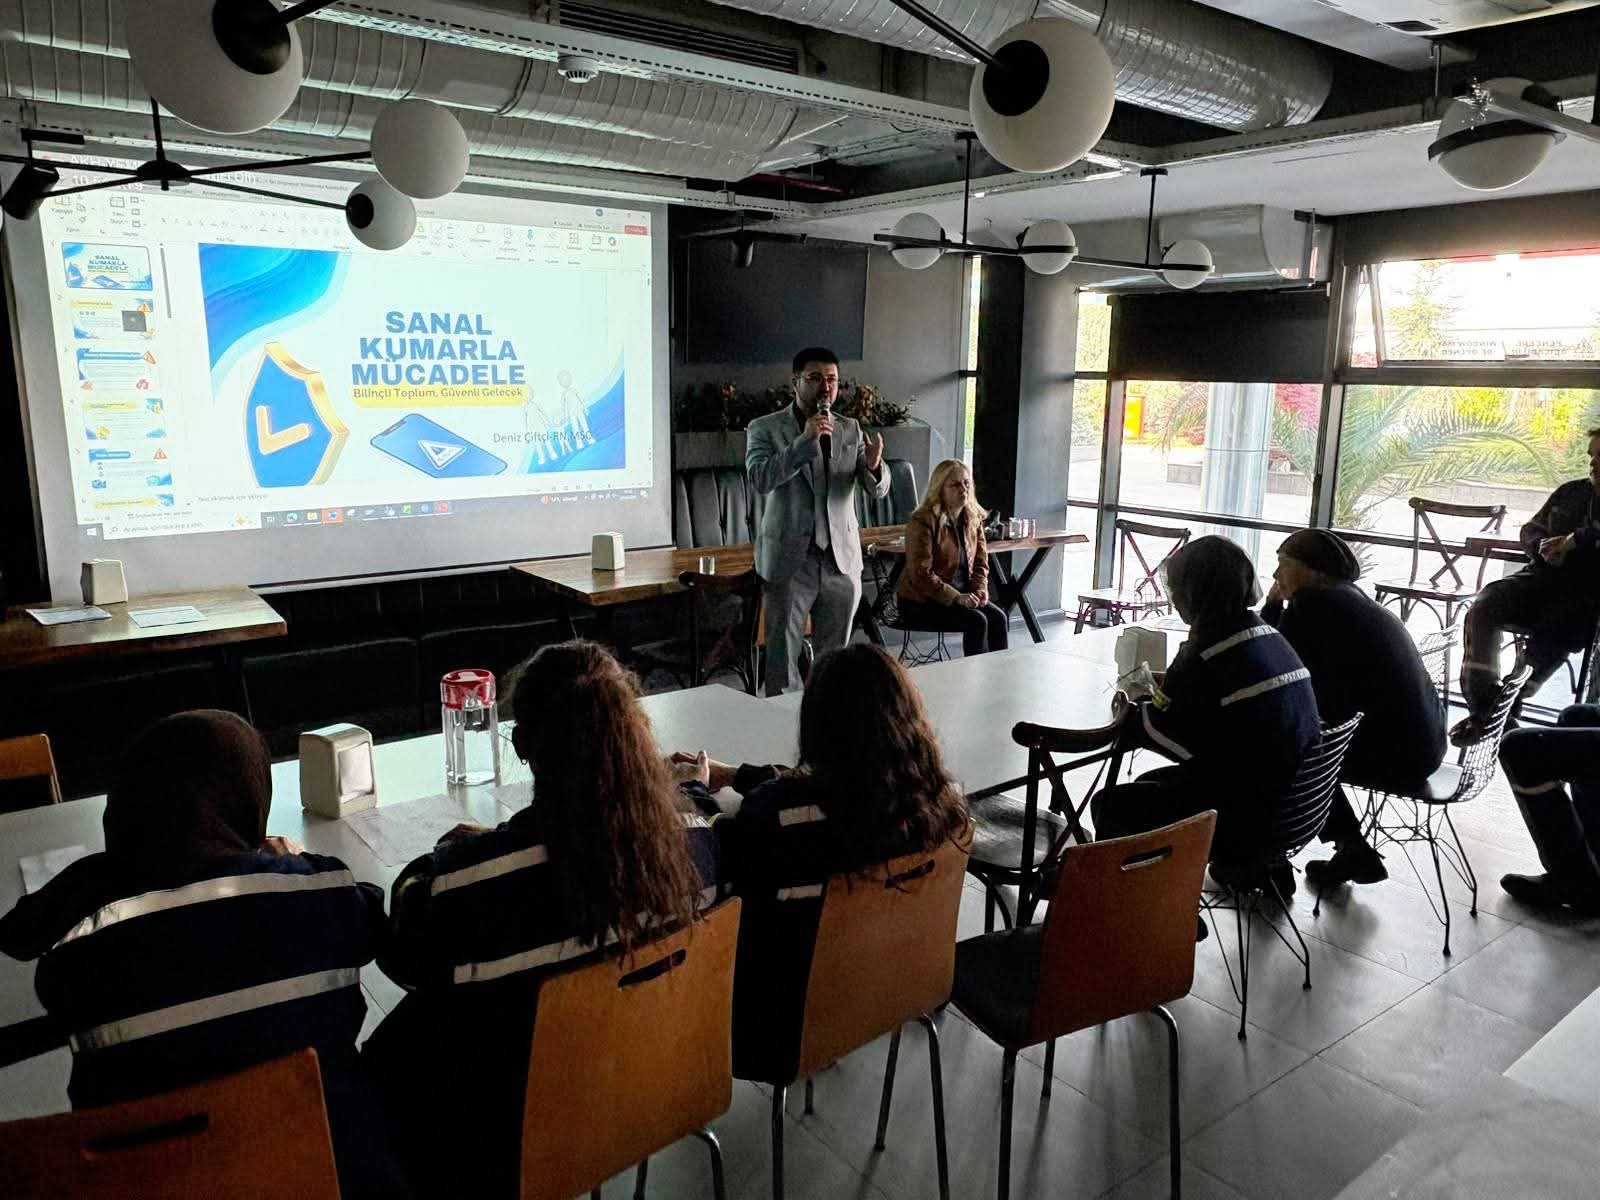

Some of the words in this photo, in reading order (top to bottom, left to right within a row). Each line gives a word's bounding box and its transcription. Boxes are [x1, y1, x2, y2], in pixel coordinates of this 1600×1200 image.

[386, 311, 492, 335] SANAL
[360, 337, 517, 361] KUMARLA
[351, 358, 526, 386] MÜCADELE
[353, 388, 392, 400] Bilinçli
[394, 388, 438, 400] Toplum,
[440, 387, 480, 397] Güvenli
[482, 387, 523, 397] Gelecek
[493, 432, 522, 443] Deniz
